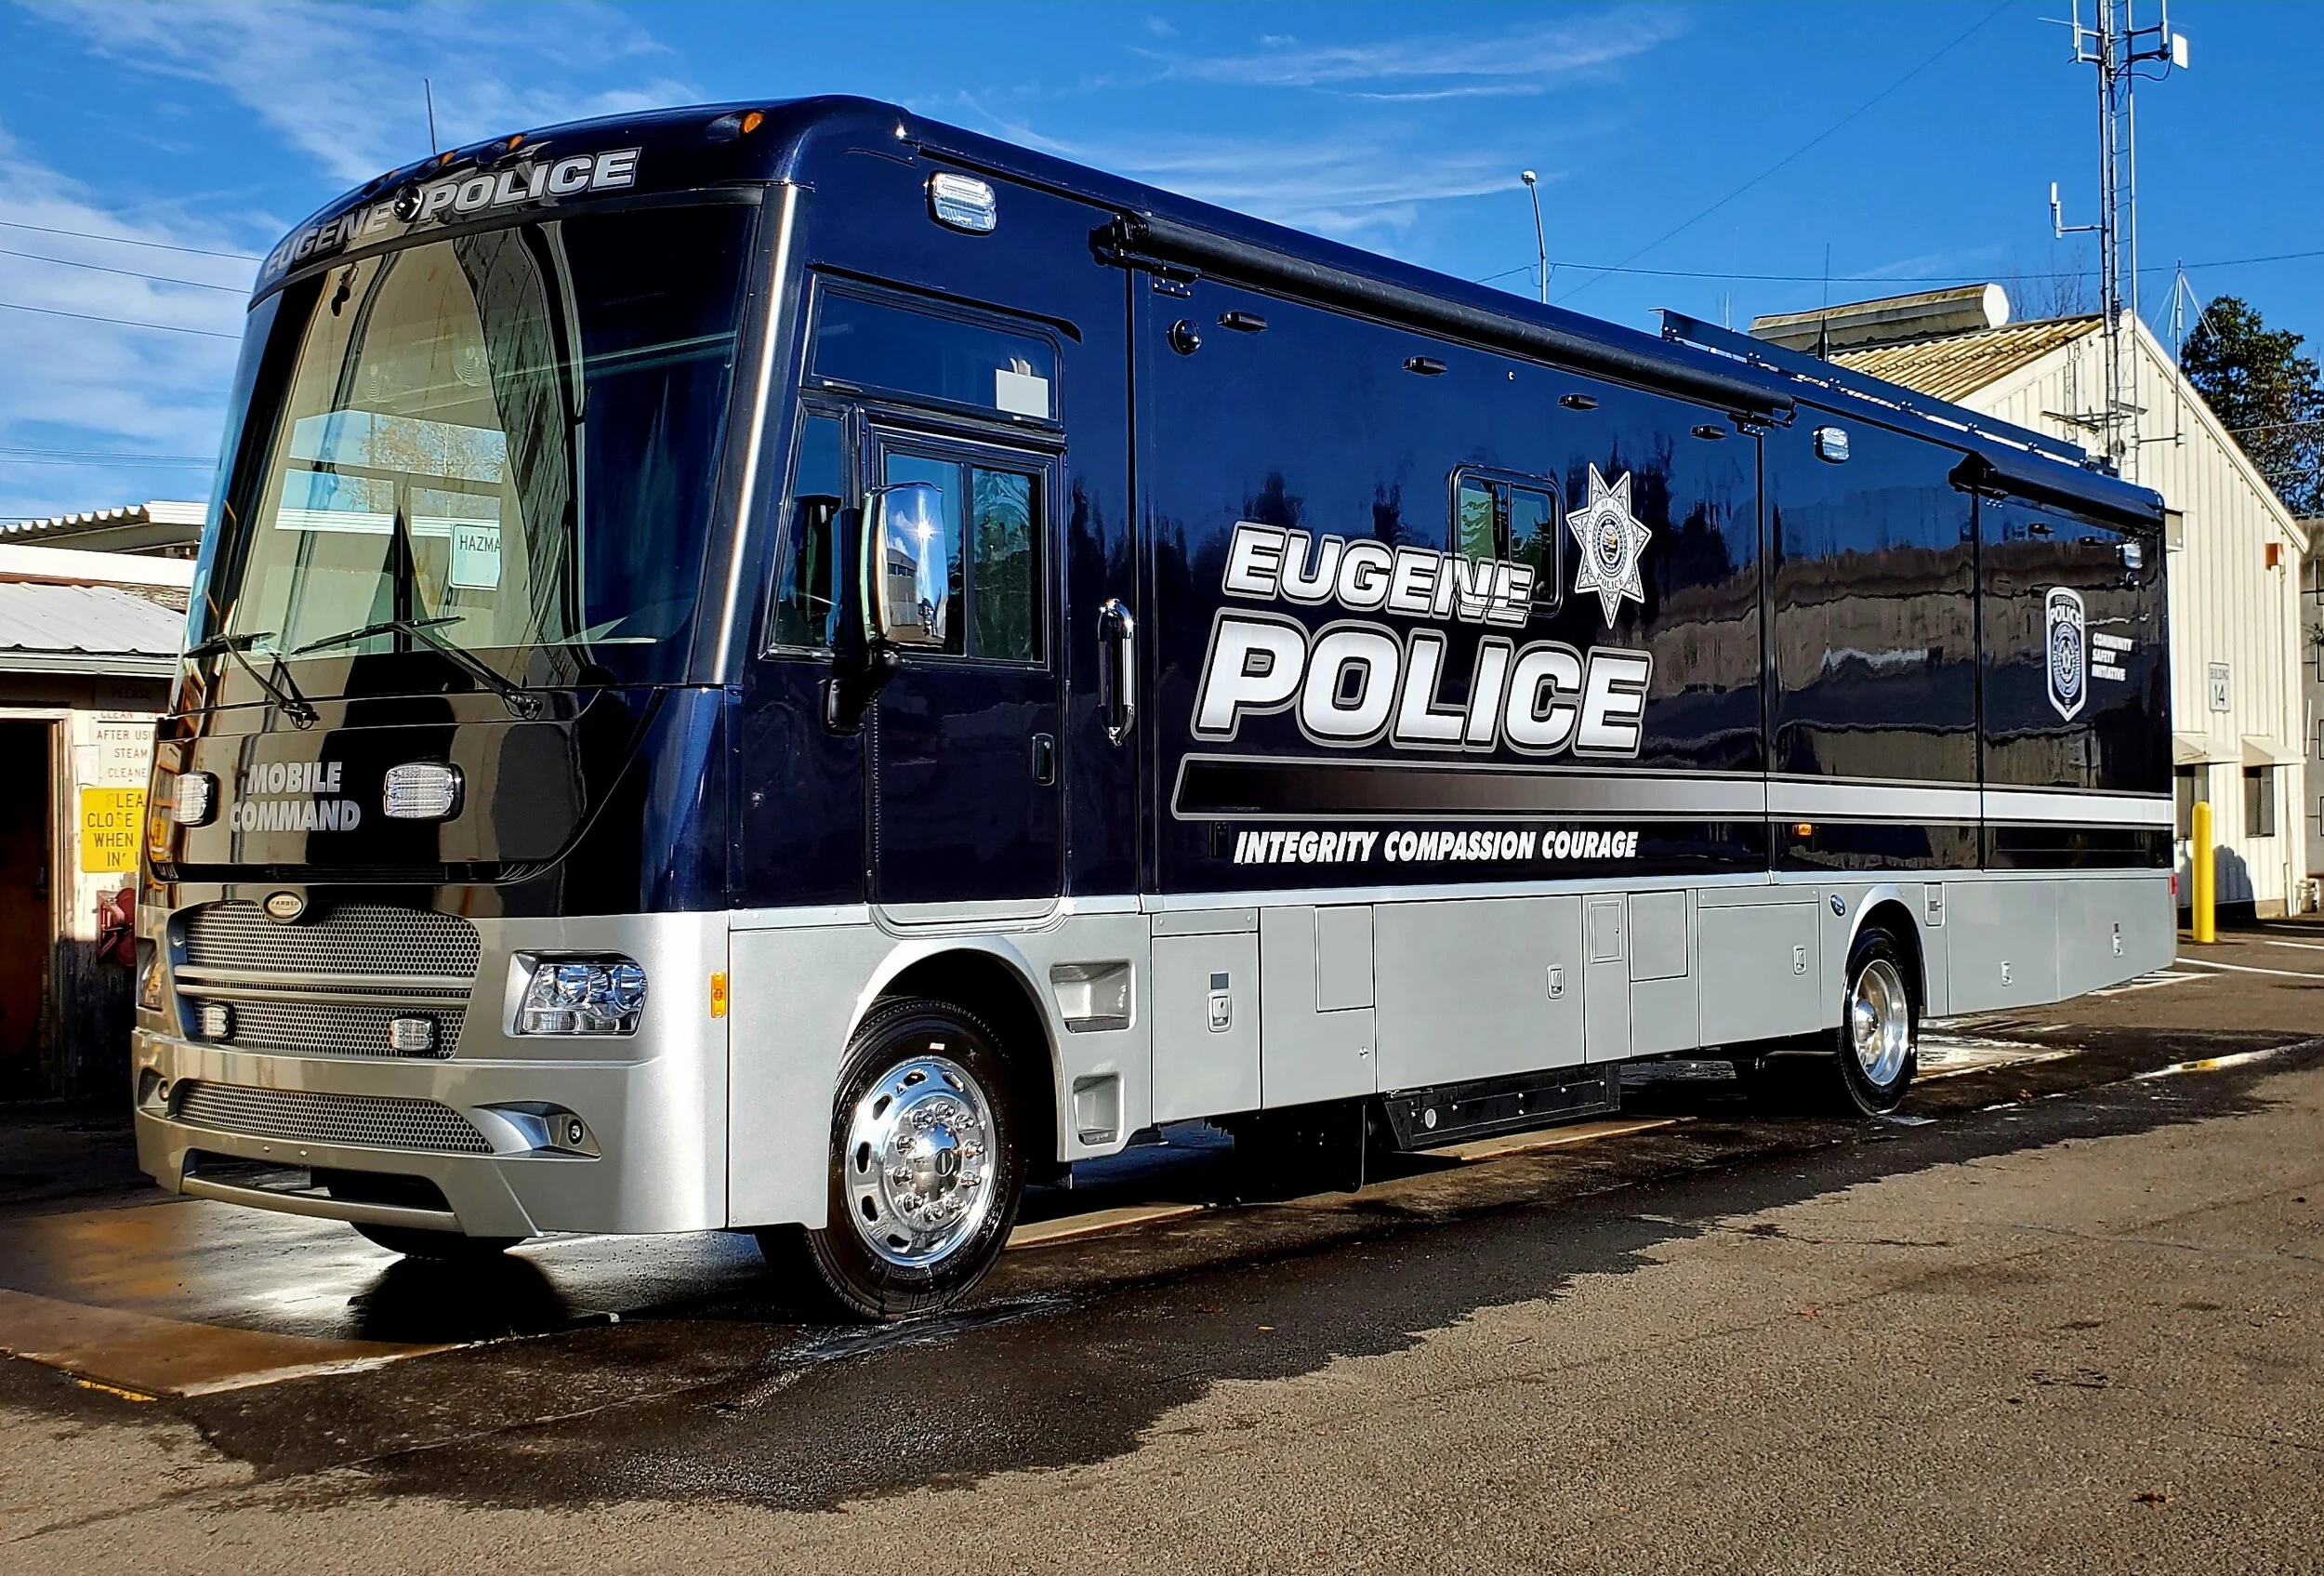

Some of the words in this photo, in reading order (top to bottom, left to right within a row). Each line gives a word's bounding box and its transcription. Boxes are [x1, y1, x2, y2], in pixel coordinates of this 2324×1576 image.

[264, 201, 392, 279] EUGENE
[417, 147, 640, 222] POLICE
[459, 535, 501, 552] HAZMA
[1223, 522, 1535, 627] EUGENE
[1596, 574, 1624, 590] POLICE
[2050, 604, 2081, 631] POLICE
[1191, 608, 1653, 758] POLICE
[2214, 684, 2225, 706] 14
[97, 730, 130, 740] AFTER
[135, 730, 153, 740] USI
[114, 748, 148, 758] STEAM
[246, 762, 342, 794] MOBILE
[230, 800, 361, 832] COMMAND
[94, 832, 134, 847] WHEN
[1234, 831, 1380, 864] INTEGRITY
[1384, 830, 1536, 861] COMPASSION
[1541, 830, 1639, 858] COURAGE
